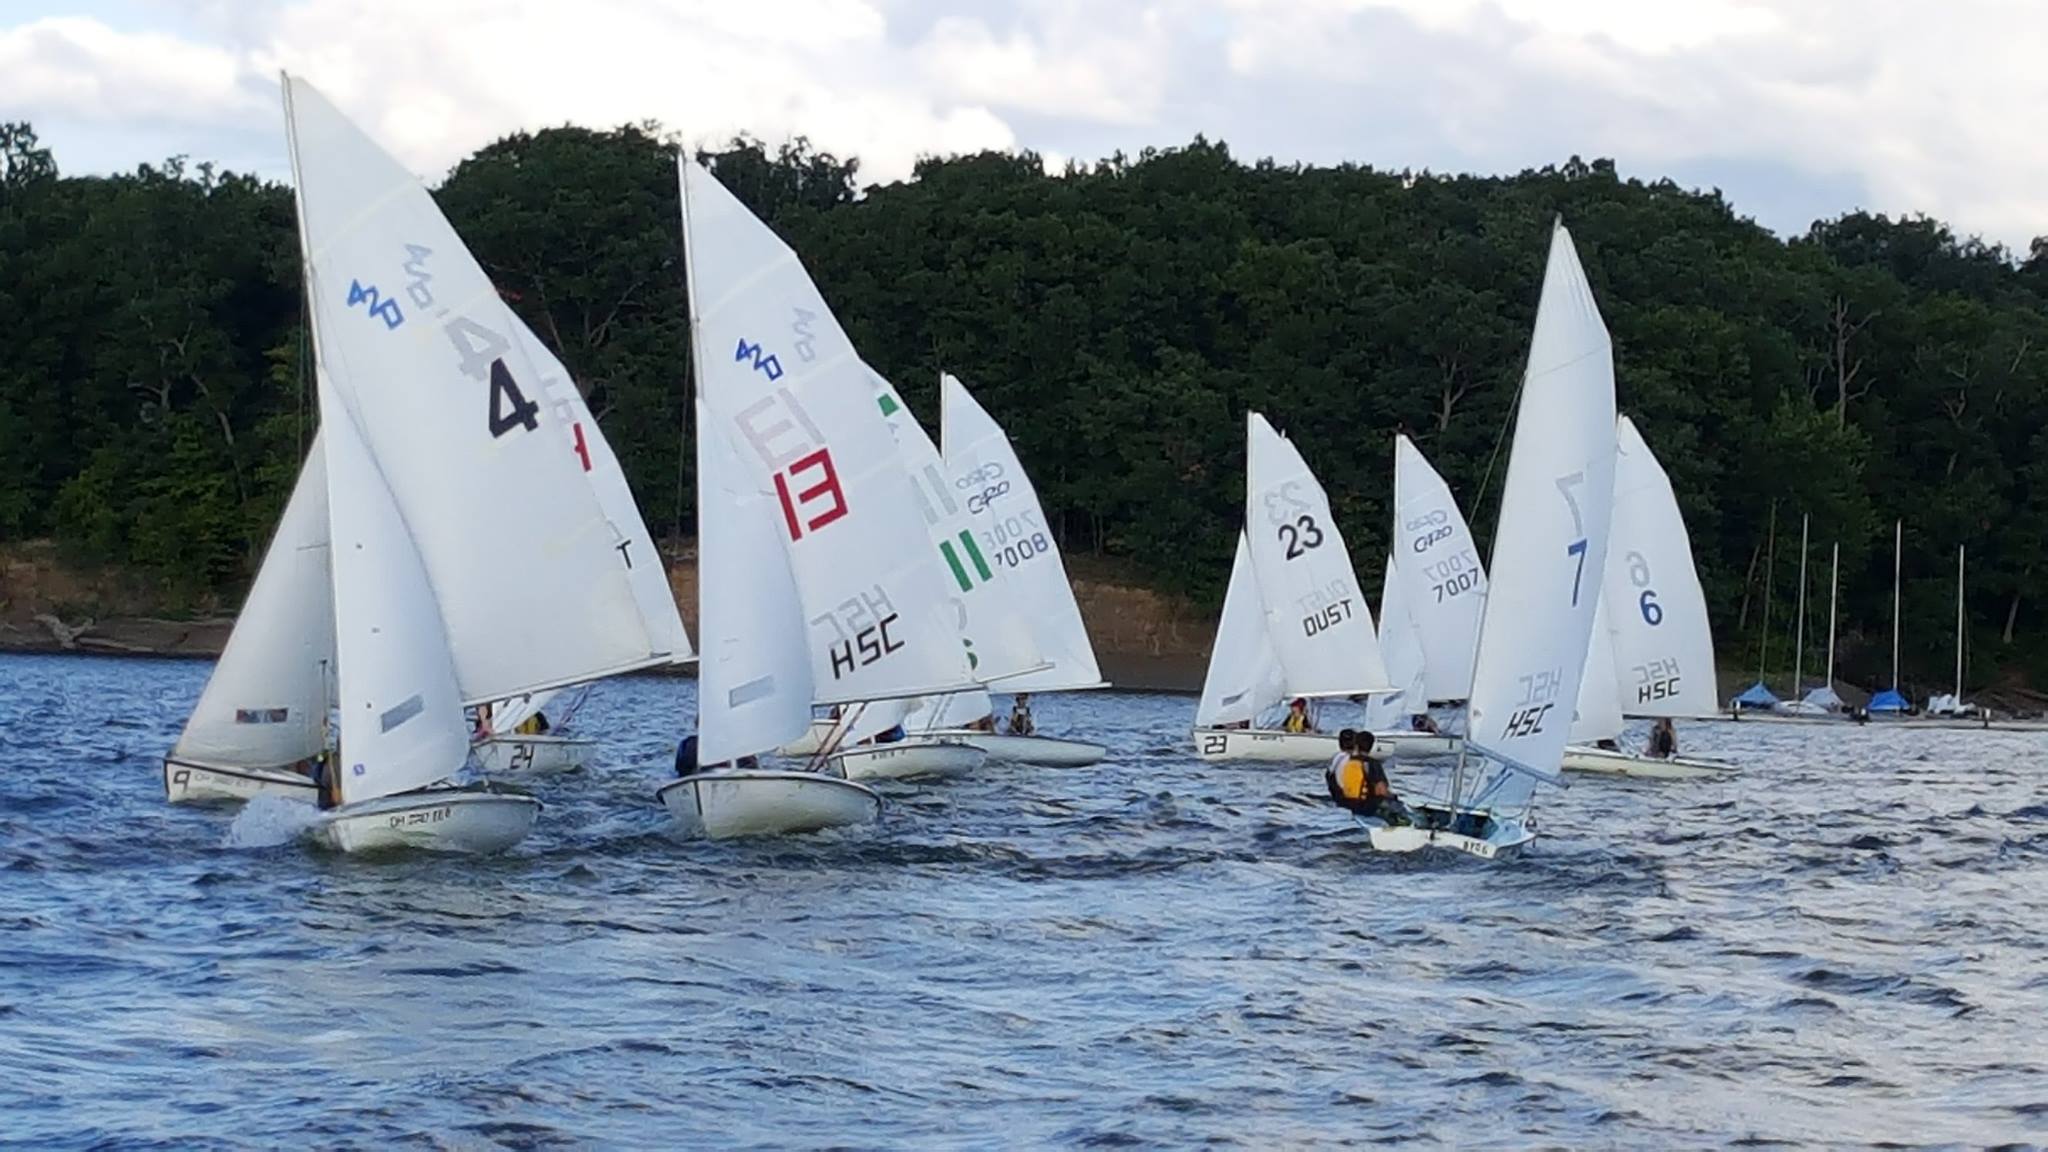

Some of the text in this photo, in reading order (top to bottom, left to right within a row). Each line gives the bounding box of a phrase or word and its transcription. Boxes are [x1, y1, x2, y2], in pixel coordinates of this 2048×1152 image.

[347, 279, 405, 330] 420
[735, 338, 783, 382] 420
[489, 356, 540, 440] 4
[773, 447, 849, 542] 13
[1277, 515, 1324, 561] 23
[940, 528, 994, 593] 11
[1568, 538, 1588, 608] 7
[1432, 566, 1479, 604] 7007
[1639, 589, 1663, 626] 6
[830, 612, 906, 680] HSC
[1638, 677, 1681, 705] HSC
[1500, 703, 1554, 741] HSC
[510, 744, 535, 770] 24
[1204, 735, 1228, 755] 23
[173, 770, 192, 795] 9
